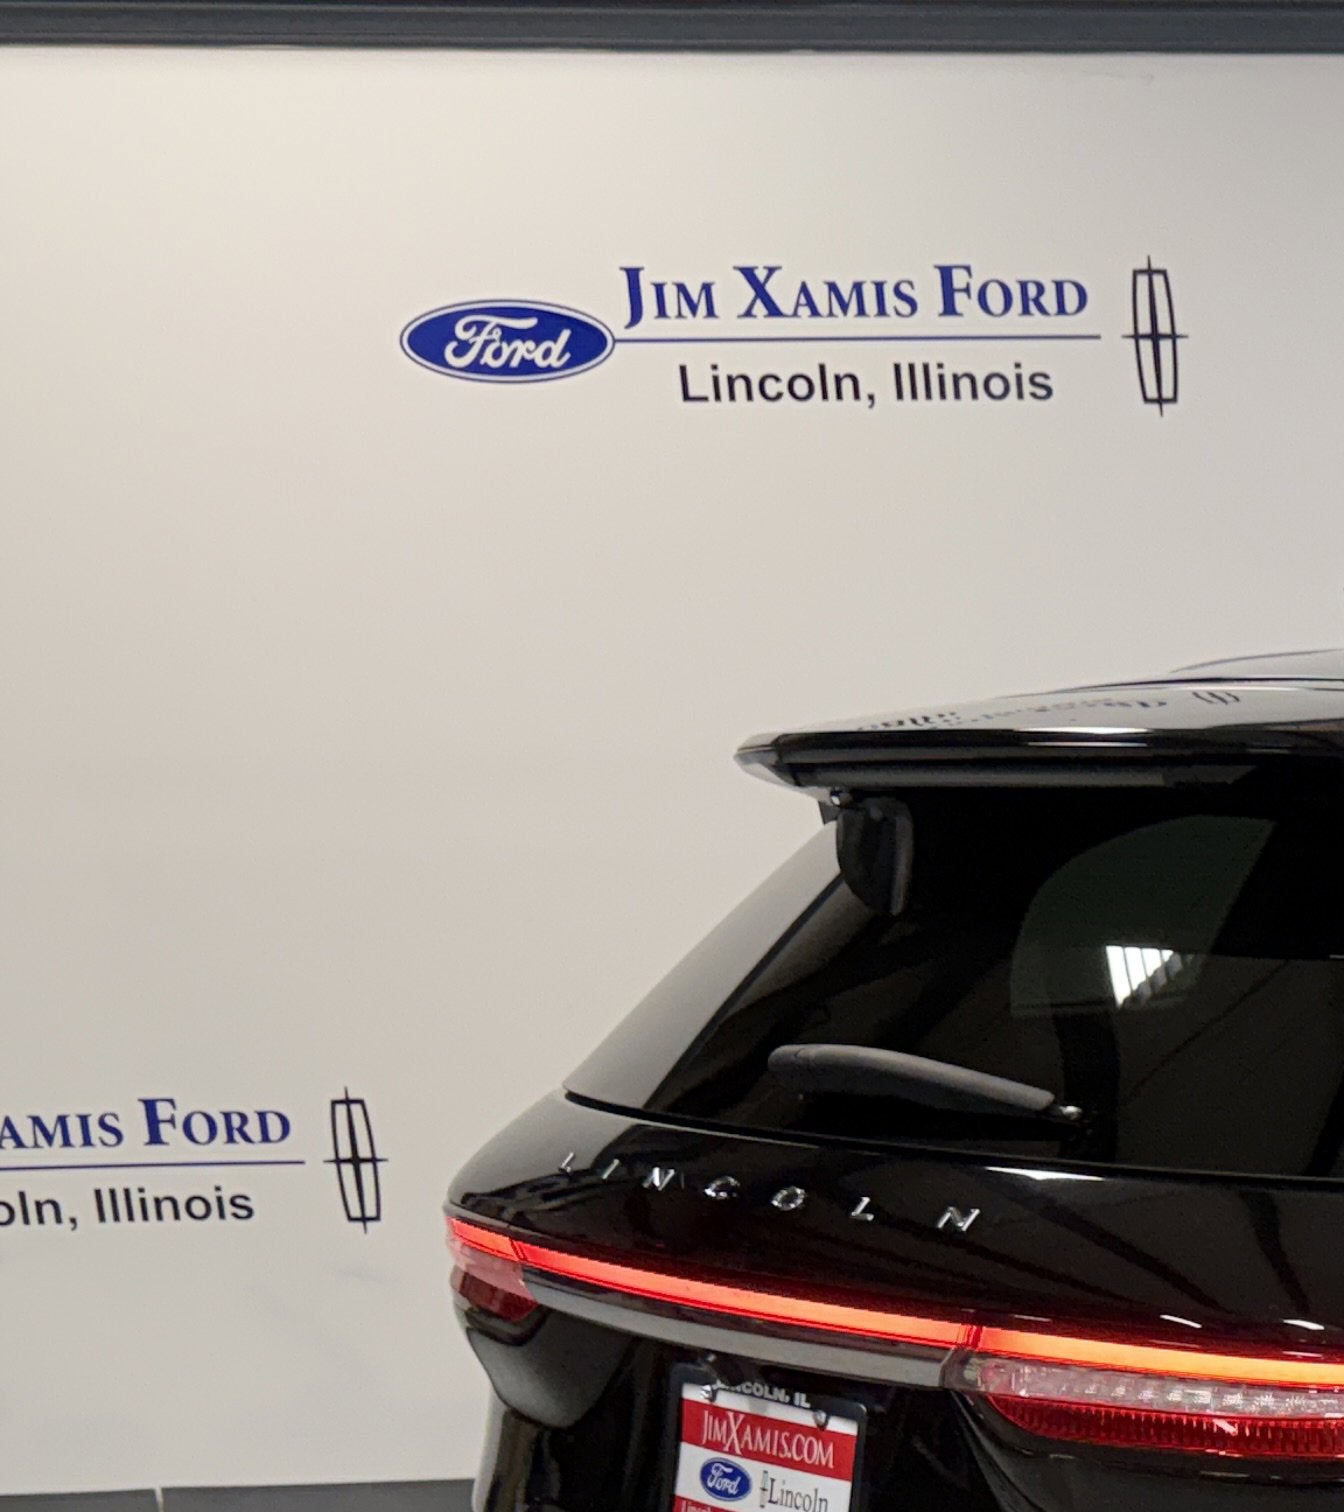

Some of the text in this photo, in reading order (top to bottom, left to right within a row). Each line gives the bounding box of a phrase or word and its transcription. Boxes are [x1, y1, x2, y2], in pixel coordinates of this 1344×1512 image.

[619, 264, 1089, 330] JIM XAMIS FORD
[444, 314, 571, 368] Ford
[678, 361, 1054, 409] Lincoln, Illinois
[137, 1097, 292, 1147] FORD
[93, 1184, 255, 1224] Illinois
[559, 1151, 981, 1233] LINCOLN
[794, 1391, 812, 1409] IL
[707, 1462, 741, 1496] Ford
